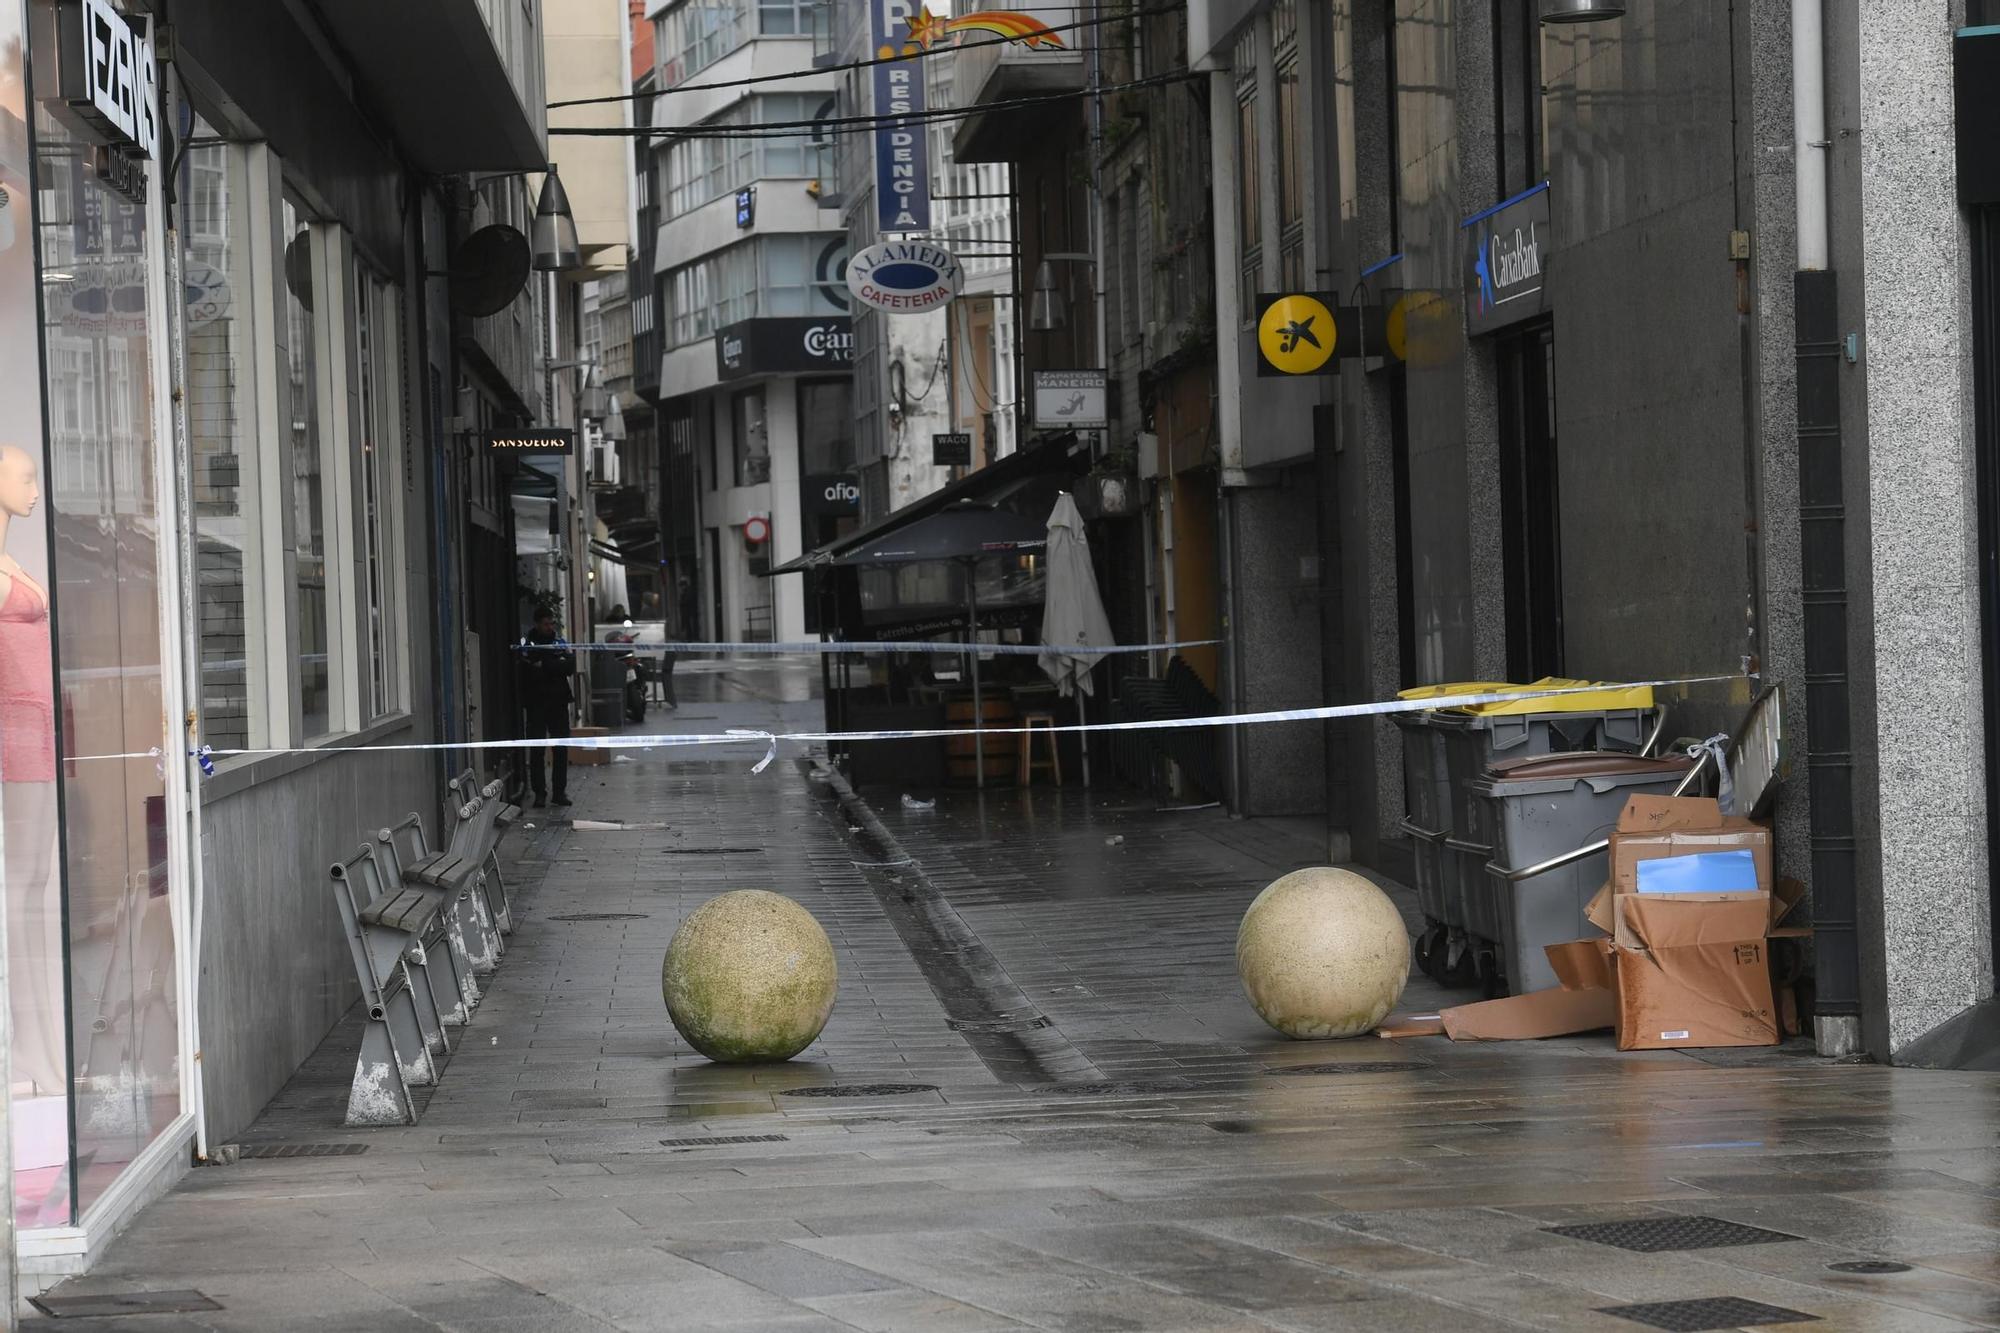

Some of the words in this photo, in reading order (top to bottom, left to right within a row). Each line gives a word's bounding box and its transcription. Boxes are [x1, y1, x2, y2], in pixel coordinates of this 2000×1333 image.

[888, 69, 916, 225] RESIDENCIA
[854, 245, 957, 281] ALAMEDA
[1492, 220, 1540, 289] CaixaBank
[861, 285, 950, 308] CAFETERIA
[1037, 379, 1104, 387] MANEIRO
[937, 435, 968, 444] WACO
